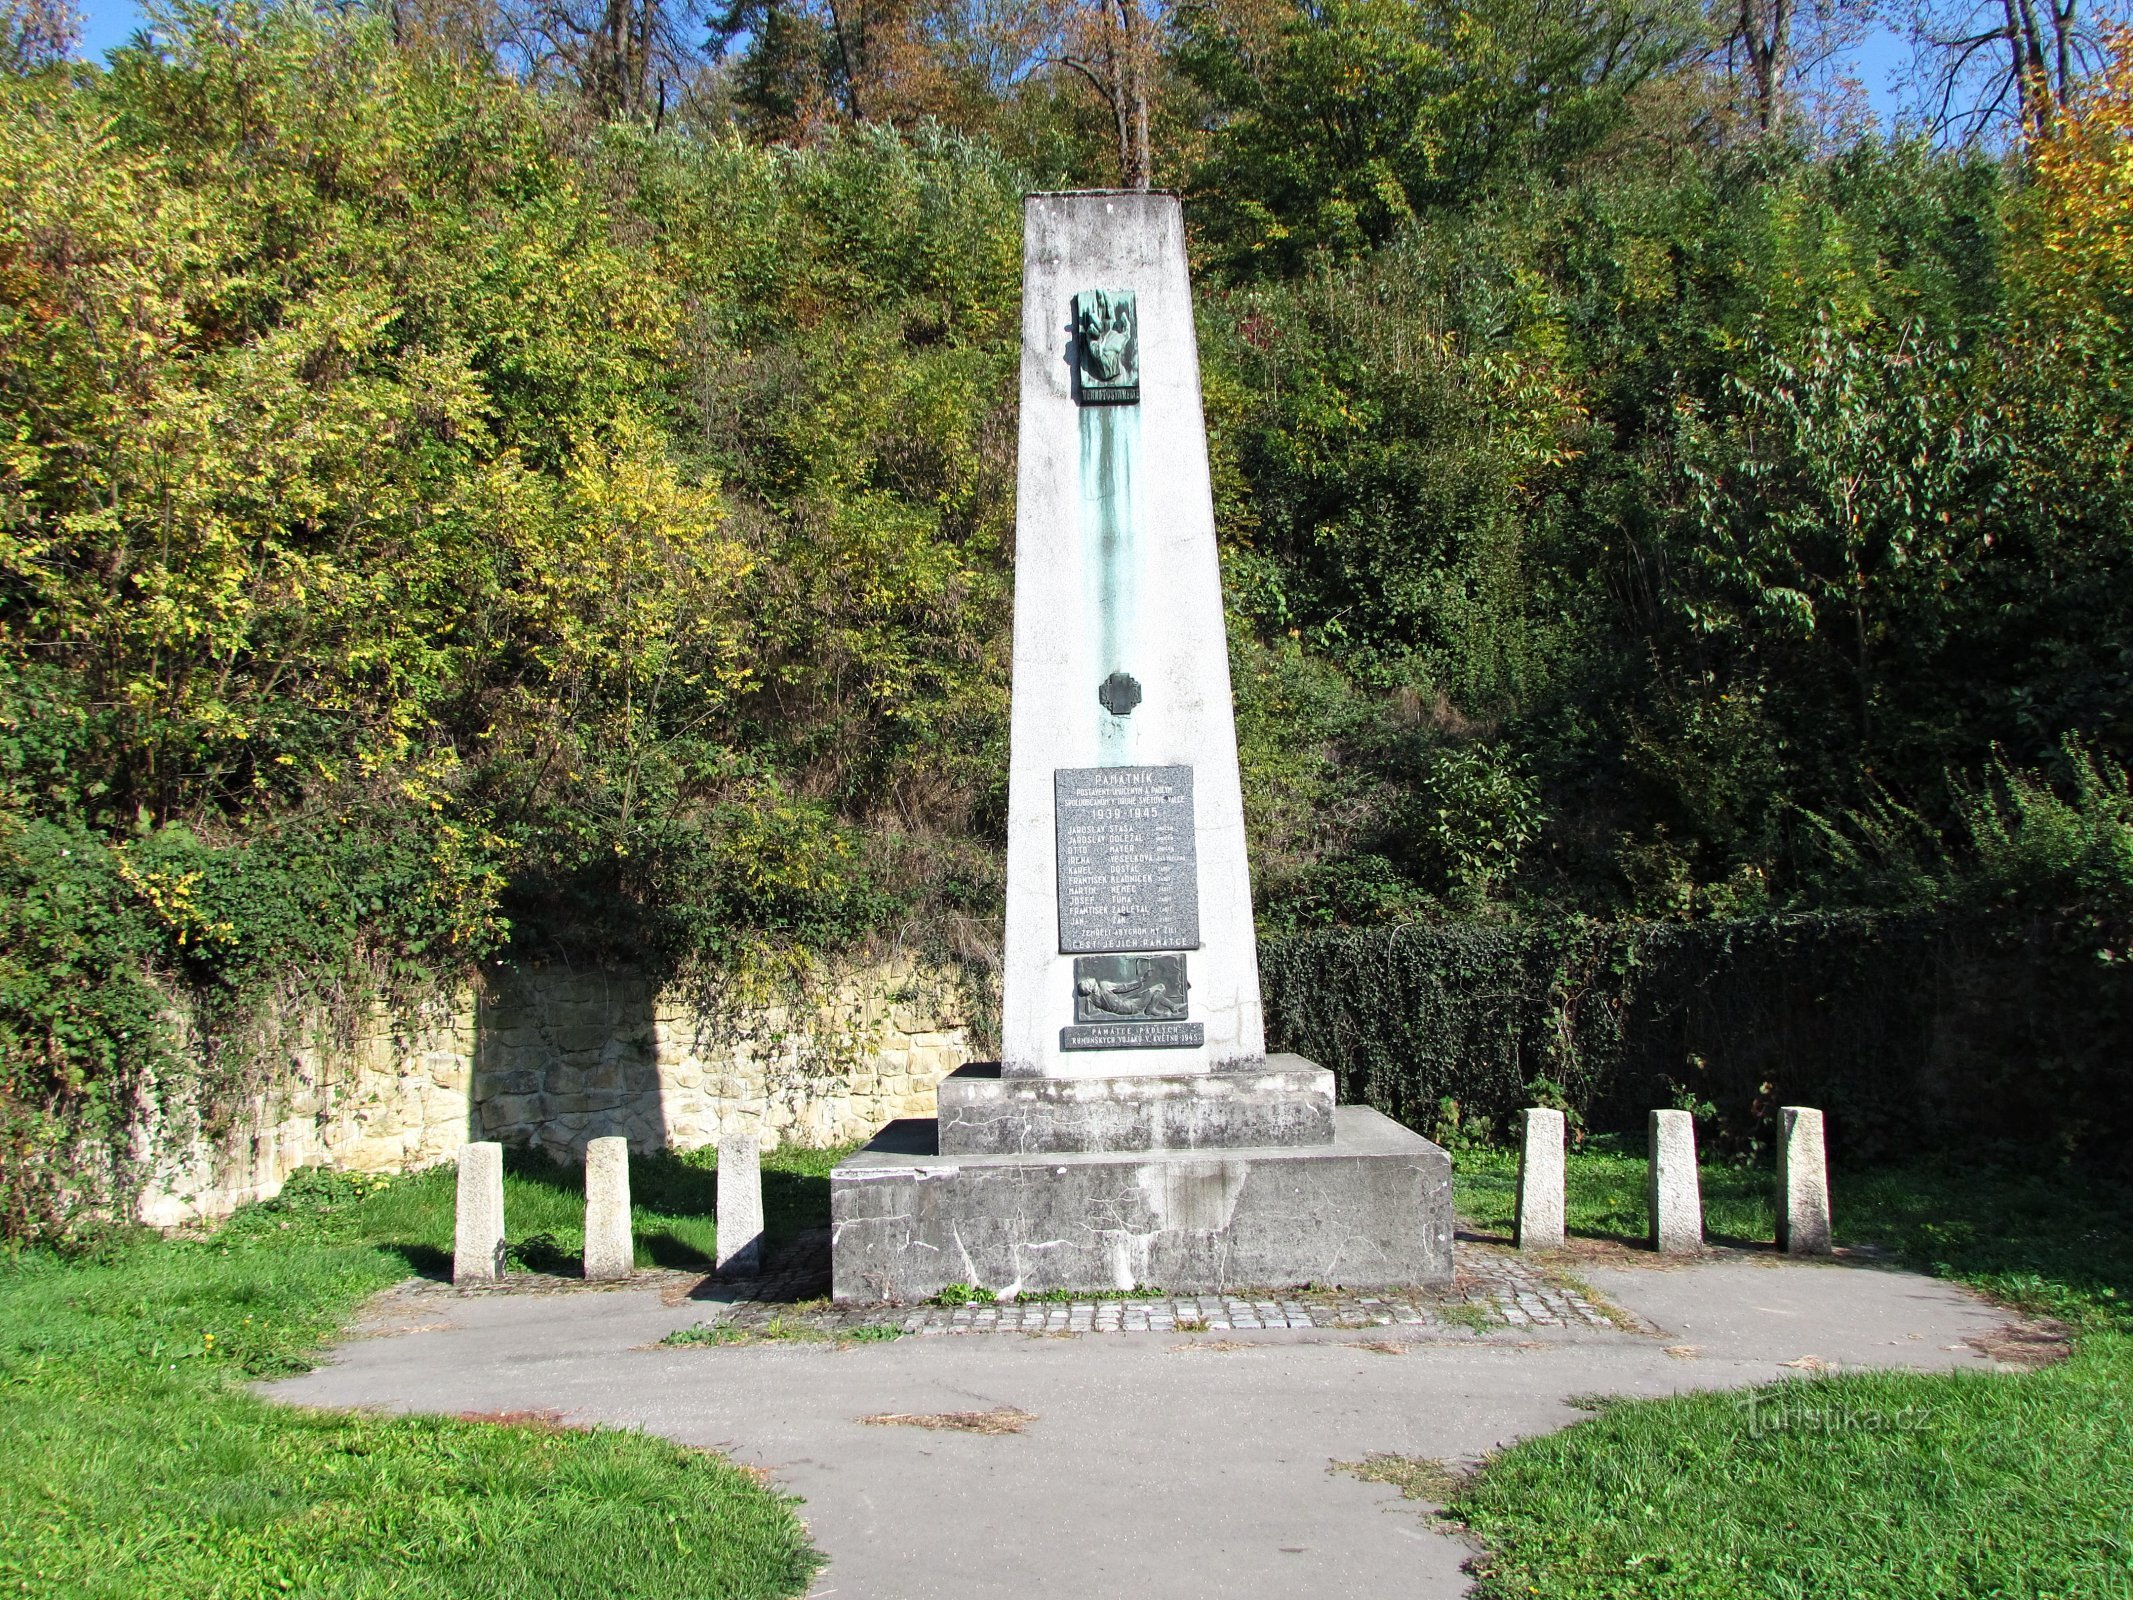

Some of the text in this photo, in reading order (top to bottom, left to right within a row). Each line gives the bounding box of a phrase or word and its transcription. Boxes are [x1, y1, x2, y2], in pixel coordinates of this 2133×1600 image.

[1068, 826, 1105, 834] JAROSLAV
[1068, 836, 1105, 844] JAROSLAV
[1068, 846, 1088, 854] OTTO
[1110, 844, 1134, 853] MAYER
[1068, 856, 1090, 865] IRENA
[1068, 866, 1092, 875] KAREL
[1070, 896, 1094, 905] JOSEF
[1103, 938, 1138, 948] JEJICH
